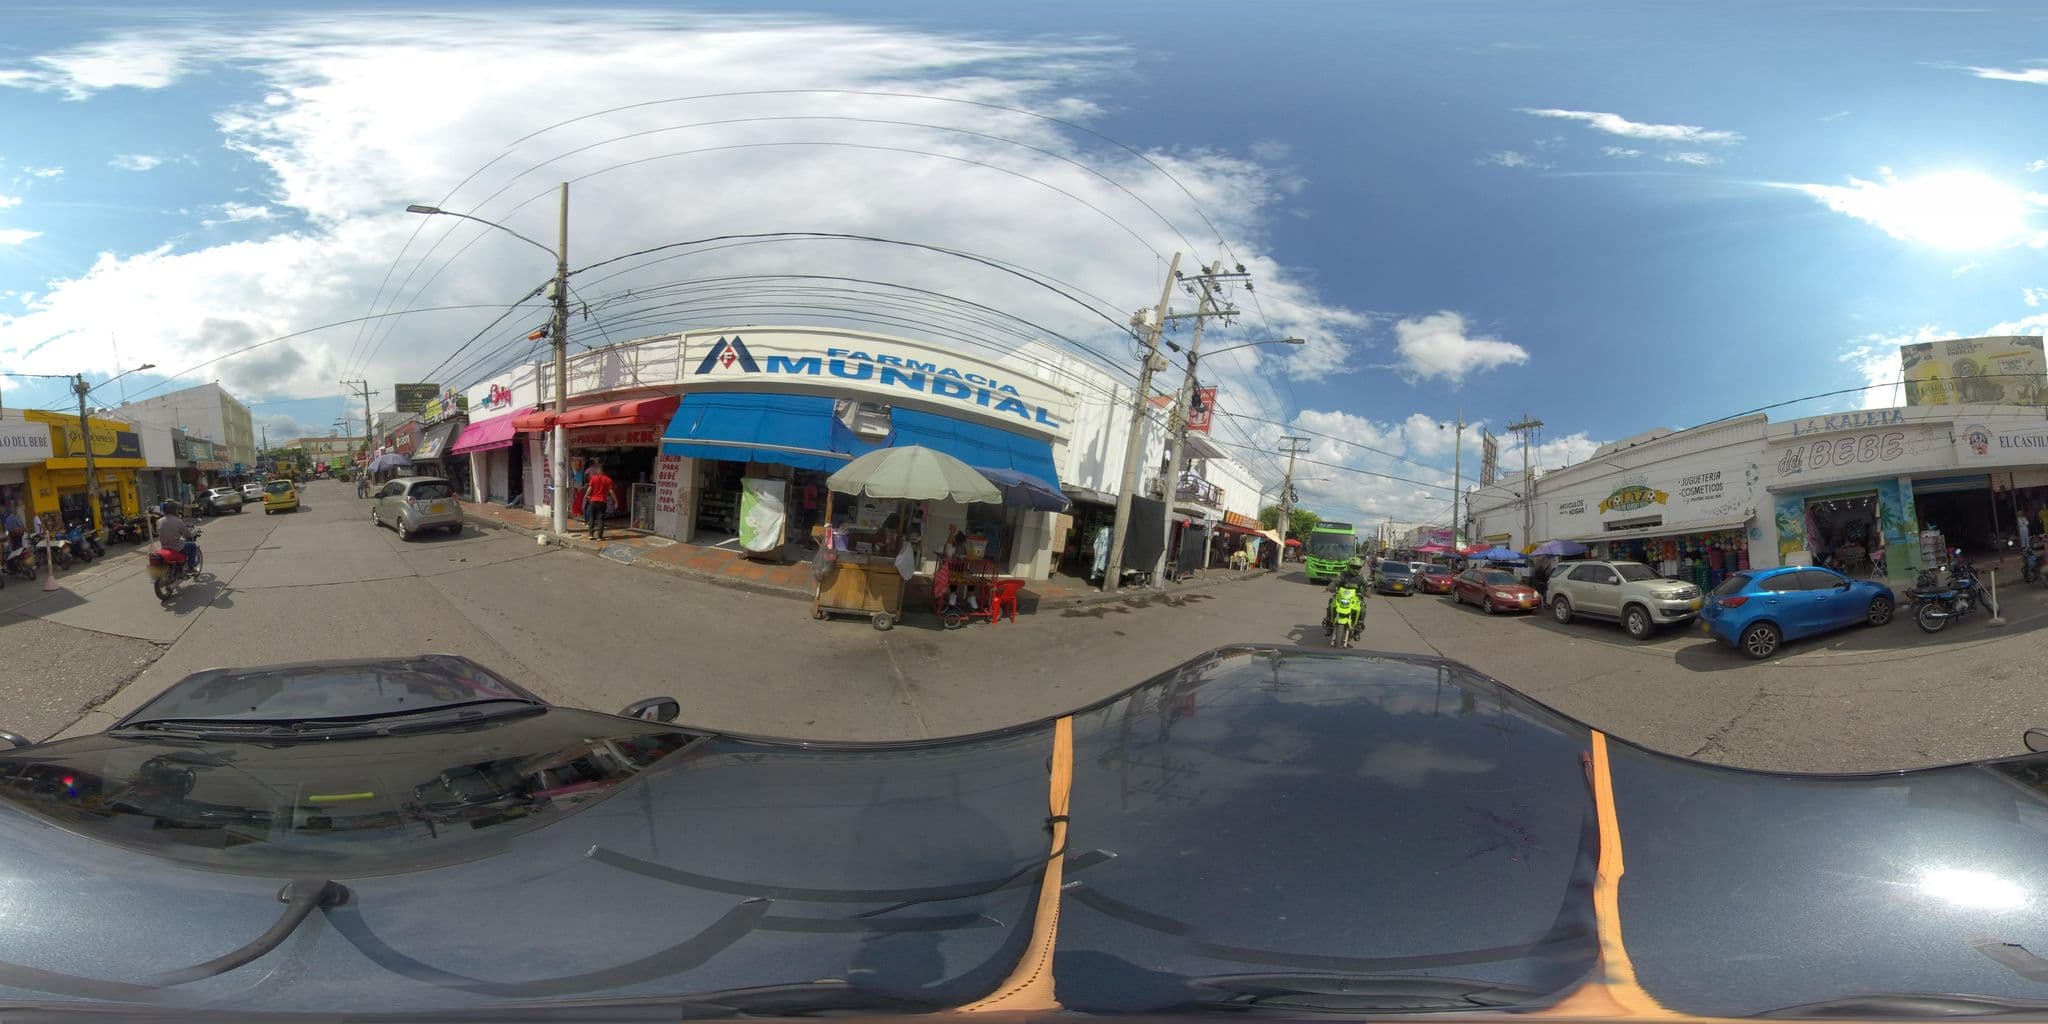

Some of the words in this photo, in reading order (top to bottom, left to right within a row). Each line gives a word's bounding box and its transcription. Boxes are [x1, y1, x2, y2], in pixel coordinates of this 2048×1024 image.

[827, 347, 1021, 397] FARMACIA
[766, 355, 1060, 429] MUNDIAL
[1792, 420, 1820, 436] LA
[1824, 409, 1905, 431] KALETA
[12, 435, 29, 448] DEL
[29, 433, 48, 448] BEBÉ
[1999, 435, 2013, 448] EL
[2014, 434, 2048, 448] CASTIL
[1778, 446, 1802, 475] del
[1808, 432, 1905, 470] BEBE
[1680, 470, 1721, 487] JUGUETERIA
[1681, 482, 1724, 498] COSMETICOS
